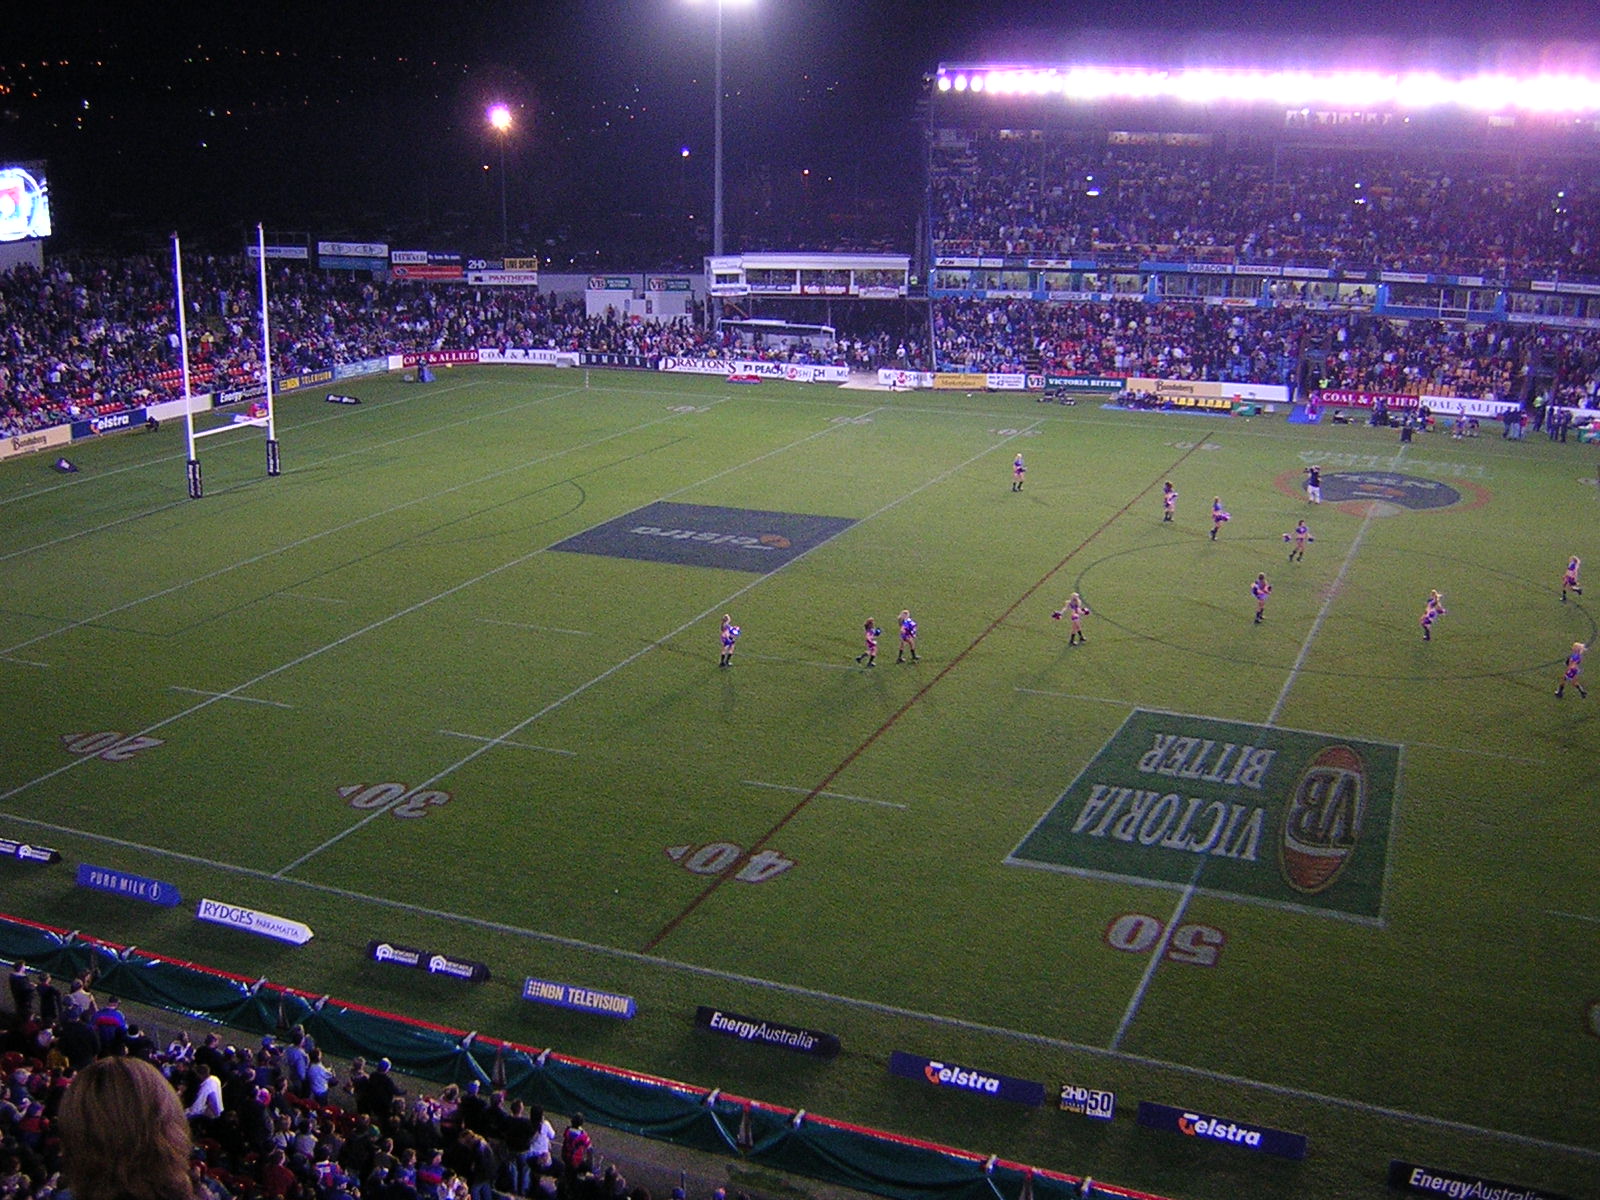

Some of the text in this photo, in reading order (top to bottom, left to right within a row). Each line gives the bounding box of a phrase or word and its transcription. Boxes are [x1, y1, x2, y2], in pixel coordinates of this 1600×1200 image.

[468, 259, 487, 270] 2HD
[439, 351, 478, 362] ALLIED
[664, 356, 737, 374] DRAYTON'S
[1027, 375, 1046, 389] VB
[1049, 377, 1088, 387] VICTORIA
[1090, 380, 1123, 388] BITTER
[1322, 392, 1354, 403] COAL
[90, 415, 130, 435] Telstra
[1138, 733, 1277, 789] BITTER
[1299, 768, 1362, 849] VB
[1071, 783, 1265, 861] VICTORIA
[119, 877, 147, 896] MILK
[203, 901, 300, 937] RYDGES PARRAMATTA
[1102, 911, 1228, 969] 50
[540, 983, 629, 1014] NBN TELEVISION
[710, 1011, 815, 1049] EnergyAustralia
[924, 1061, 1000, 1093] Telstra
[1061, 1085, 1088, 1102] 2HD
[1088, 1091, 1113, 1112] 50
[1178, 1113, 1262, 1147] Telstra
